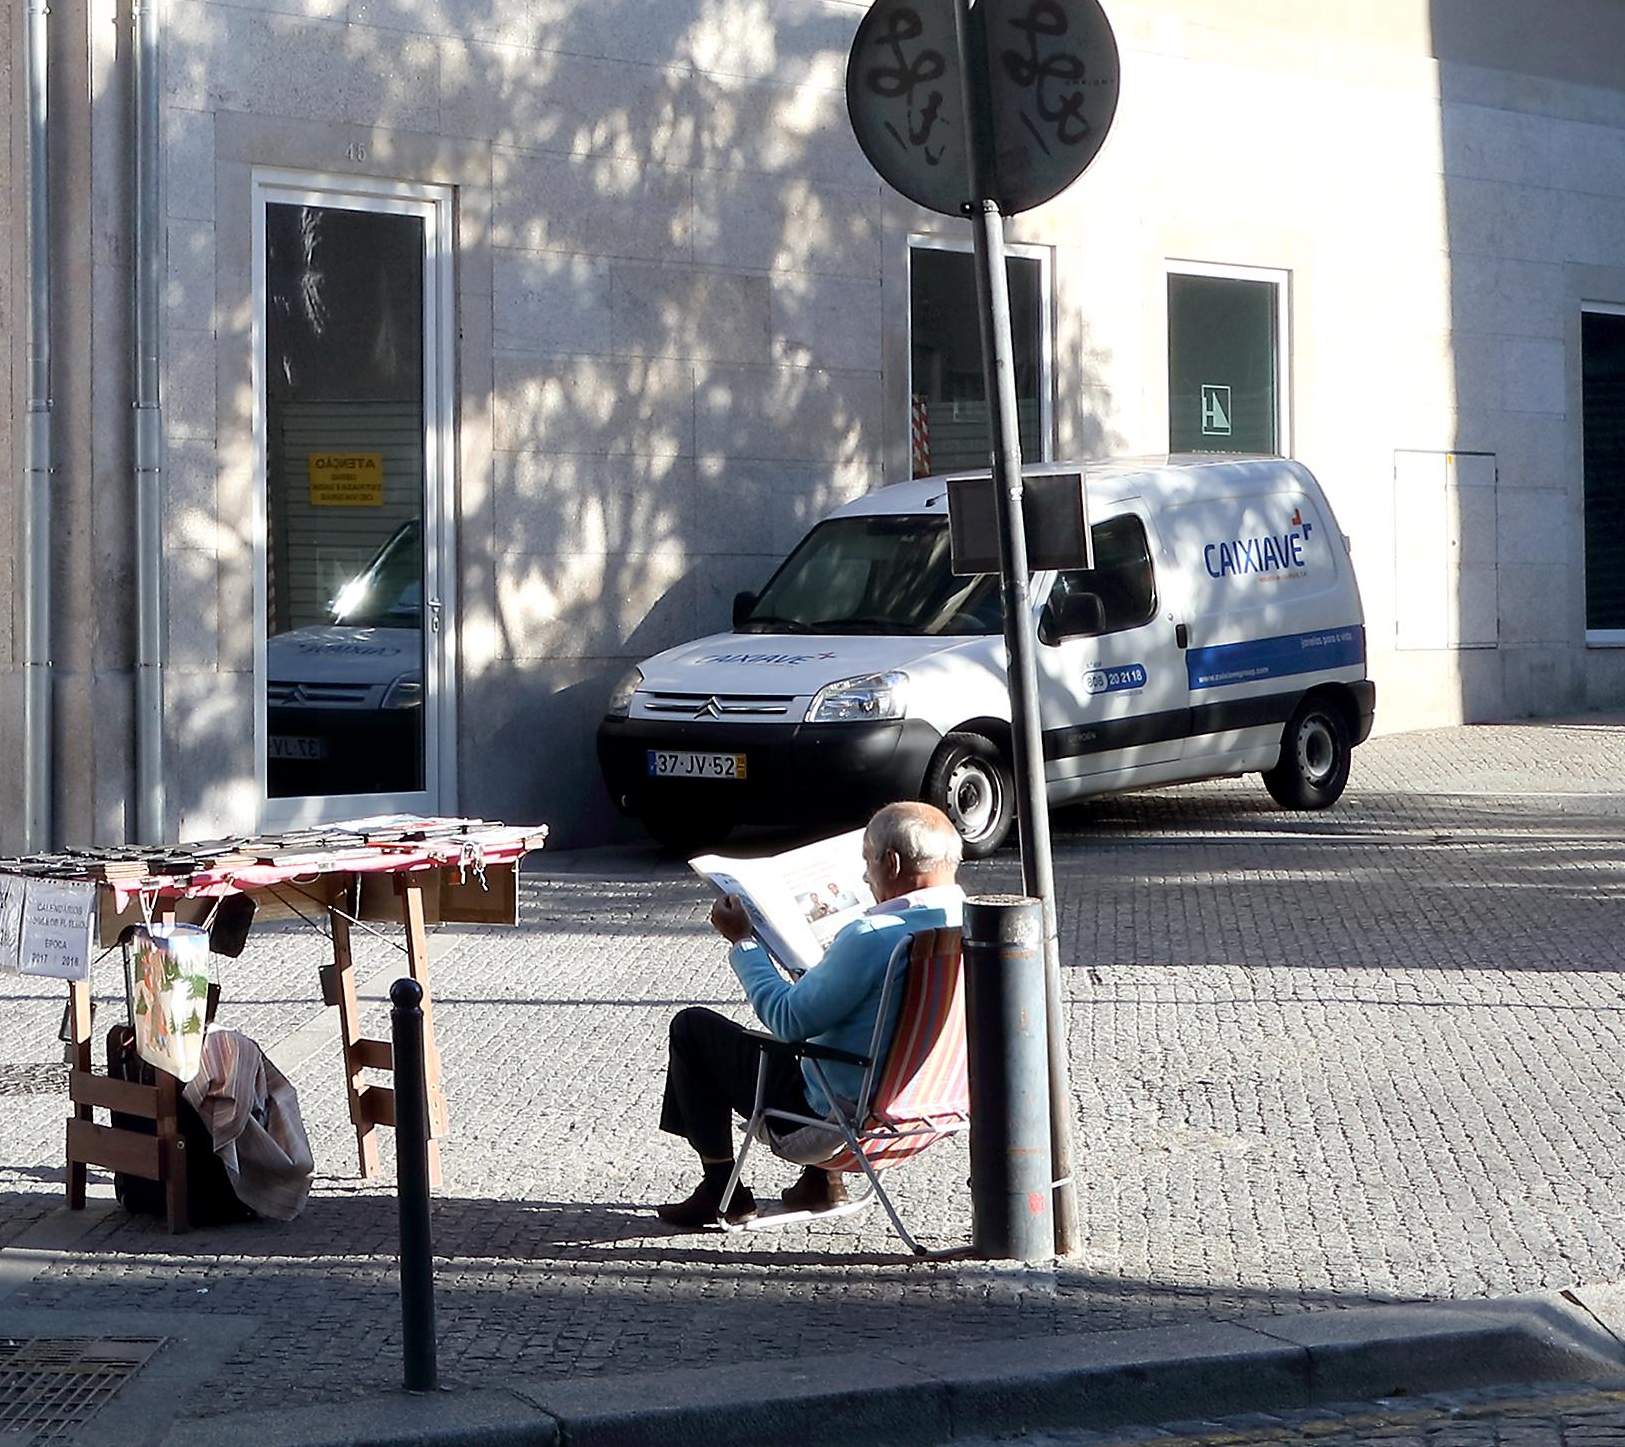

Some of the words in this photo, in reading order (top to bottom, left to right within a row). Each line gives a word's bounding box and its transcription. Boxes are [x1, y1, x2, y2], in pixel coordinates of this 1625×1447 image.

[1203, 533, 1305, 579] CAIXIAVE
[1086, 675, 1104, 687] 808
[1109, 673, 1120, 685] 20
[1121, 671, 1131, 683] 21
[1132, 669, 1143, 681] 18
